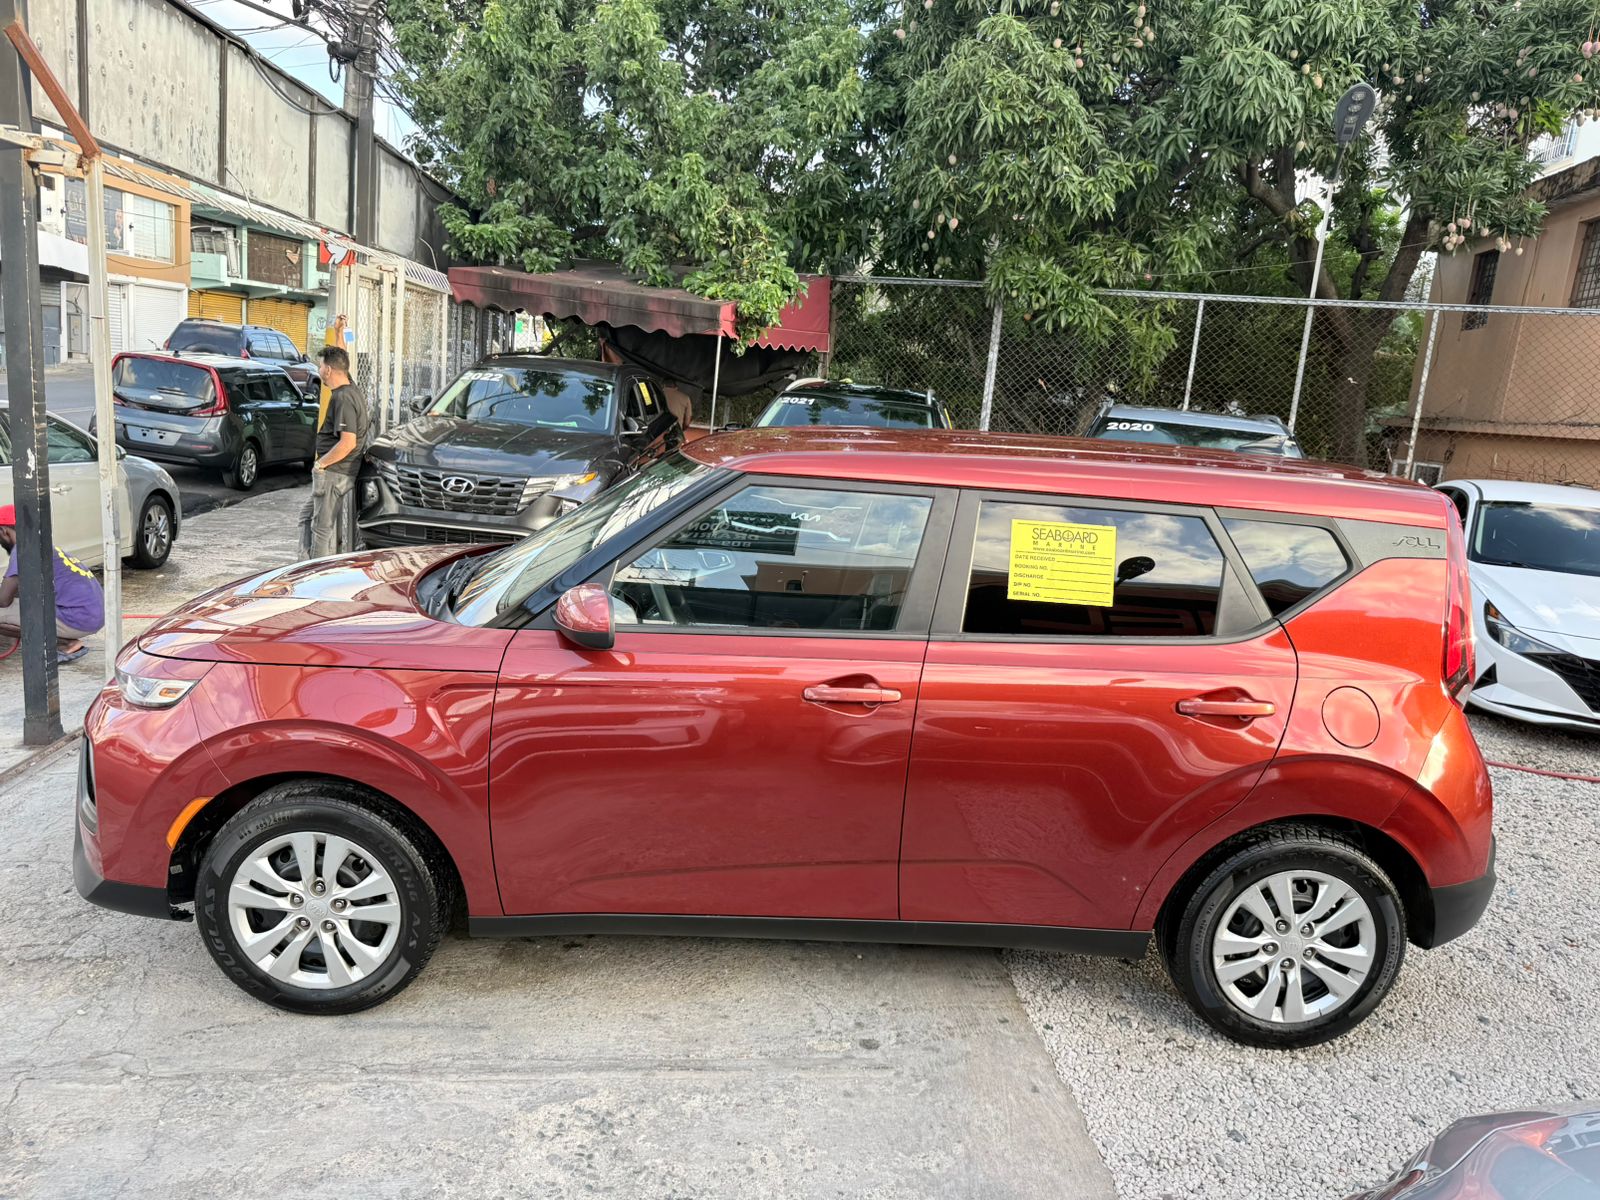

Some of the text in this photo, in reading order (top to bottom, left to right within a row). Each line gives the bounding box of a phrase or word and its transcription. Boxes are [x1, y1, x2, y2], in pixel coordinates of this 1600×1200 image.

[460, 371, 504, 382] 2022
[781, 396, 816, 406] 2021
[1106, 422, 1154, 432] 2020
[1032, 527, 1099, 544] SEABOARD
[1032, 540, 1097, 551] MARINE
[1014, 553, 1056, 563] DATE RECEIVED
[1014, 563, 1039, 571] BOOKING
[1013, 572, 1045, 580] DISCHARGE
[1012, 590, 1031, 598] SERIAL
